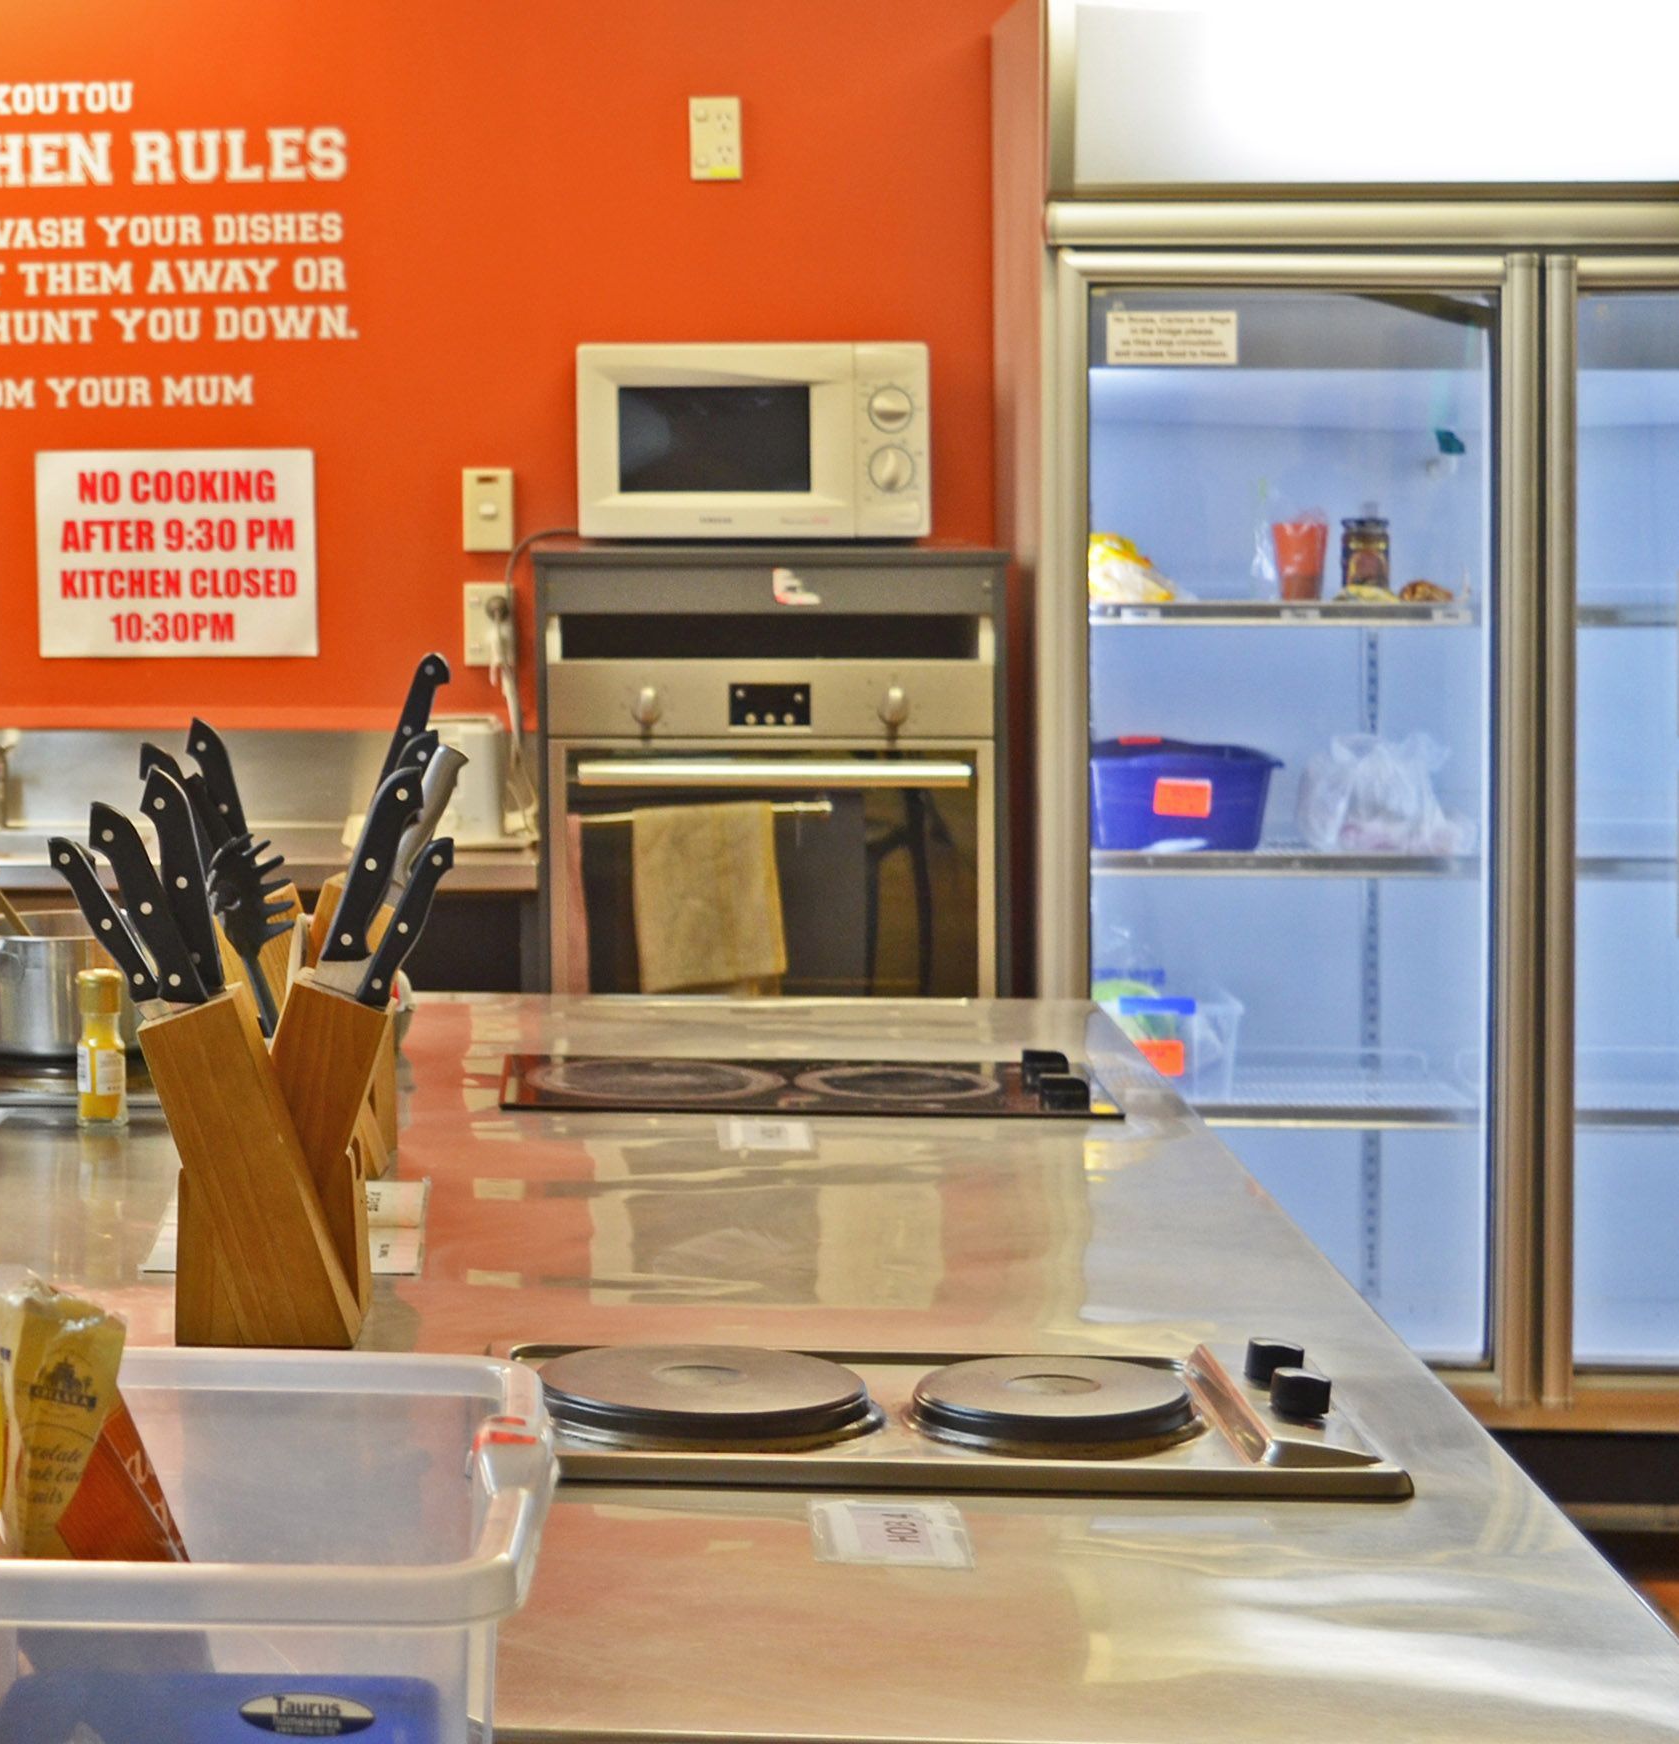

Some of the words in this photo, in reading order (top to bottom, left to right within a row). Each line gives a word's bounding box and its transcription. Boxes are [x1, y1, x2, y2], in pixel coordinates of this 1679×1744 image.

[131, 127, 347, 183] RULES
[96, 215, 202, 248] YOUR
[214, 212, 343, 245] DISHES
[19, 261, 133, 296] THEM
[147, 259, 279, 293] AWAY
[293, 257, 346, 291] OR
[111, 308, 200, 343] YOU
[215, 305, 358, 341] DOWN.
[46, 377, 151, 408] YOUR
[163, 375, 253, 406] MUM
[77, 471, 121, 504] NO
[130, 470, 276, 504] COOKING
[61, 518, 155, 553] AFTER
[165, 517, 238, 552] 9:30
[247, 517, 295, 551] PM
[60, 569, 183, 600] KITCHEN
[190, 568, 297, 599] CLOSED
[111, 612, 235, 643] 10:30PM
[273, 1693, 341, 1717] Taurus
